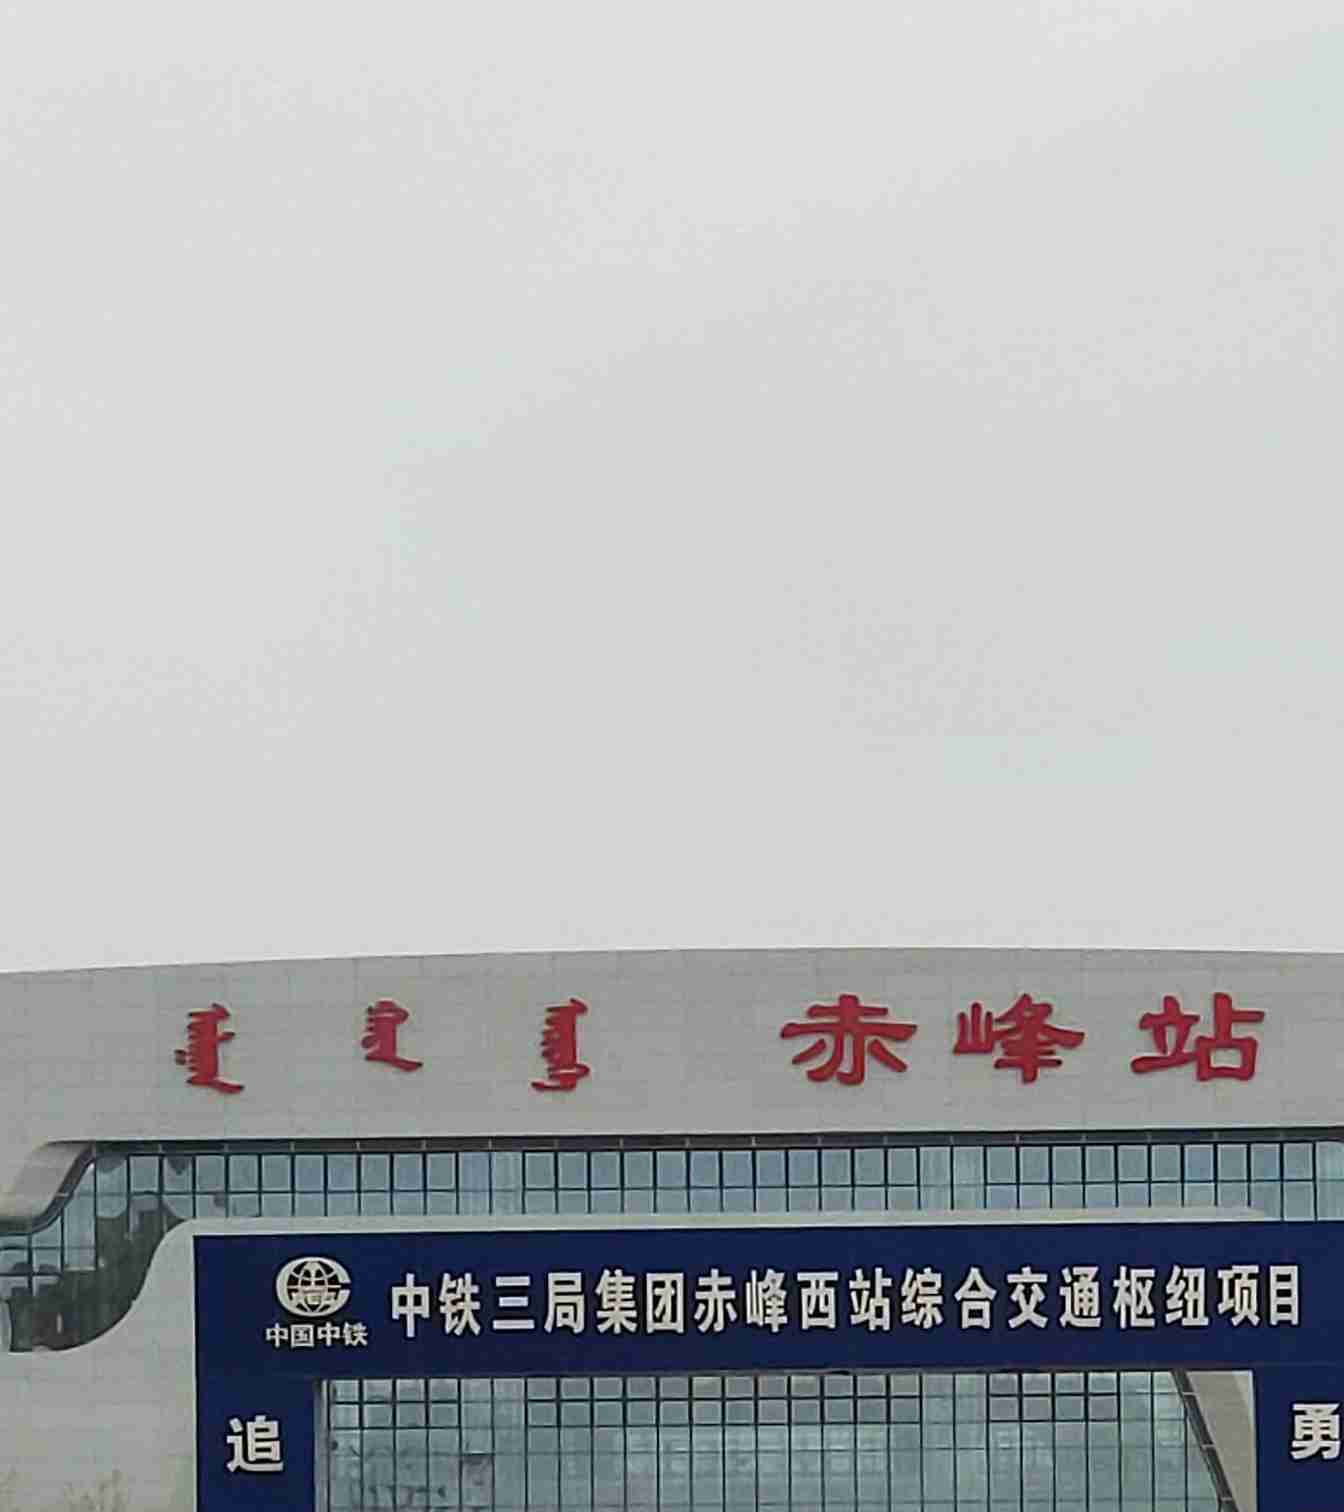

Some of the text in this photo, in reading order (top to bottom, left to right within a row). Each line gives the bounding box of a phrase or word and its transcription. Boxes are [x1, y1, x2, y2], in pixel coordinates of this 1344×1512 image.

[780, 993, 1266, 1085] 赤峰站
[265, 1323, 368, 1348] 中国中铁
[391, 1264, 1301, 1338] 中铁三局集团赤峰西站综合交通枢纽项目
